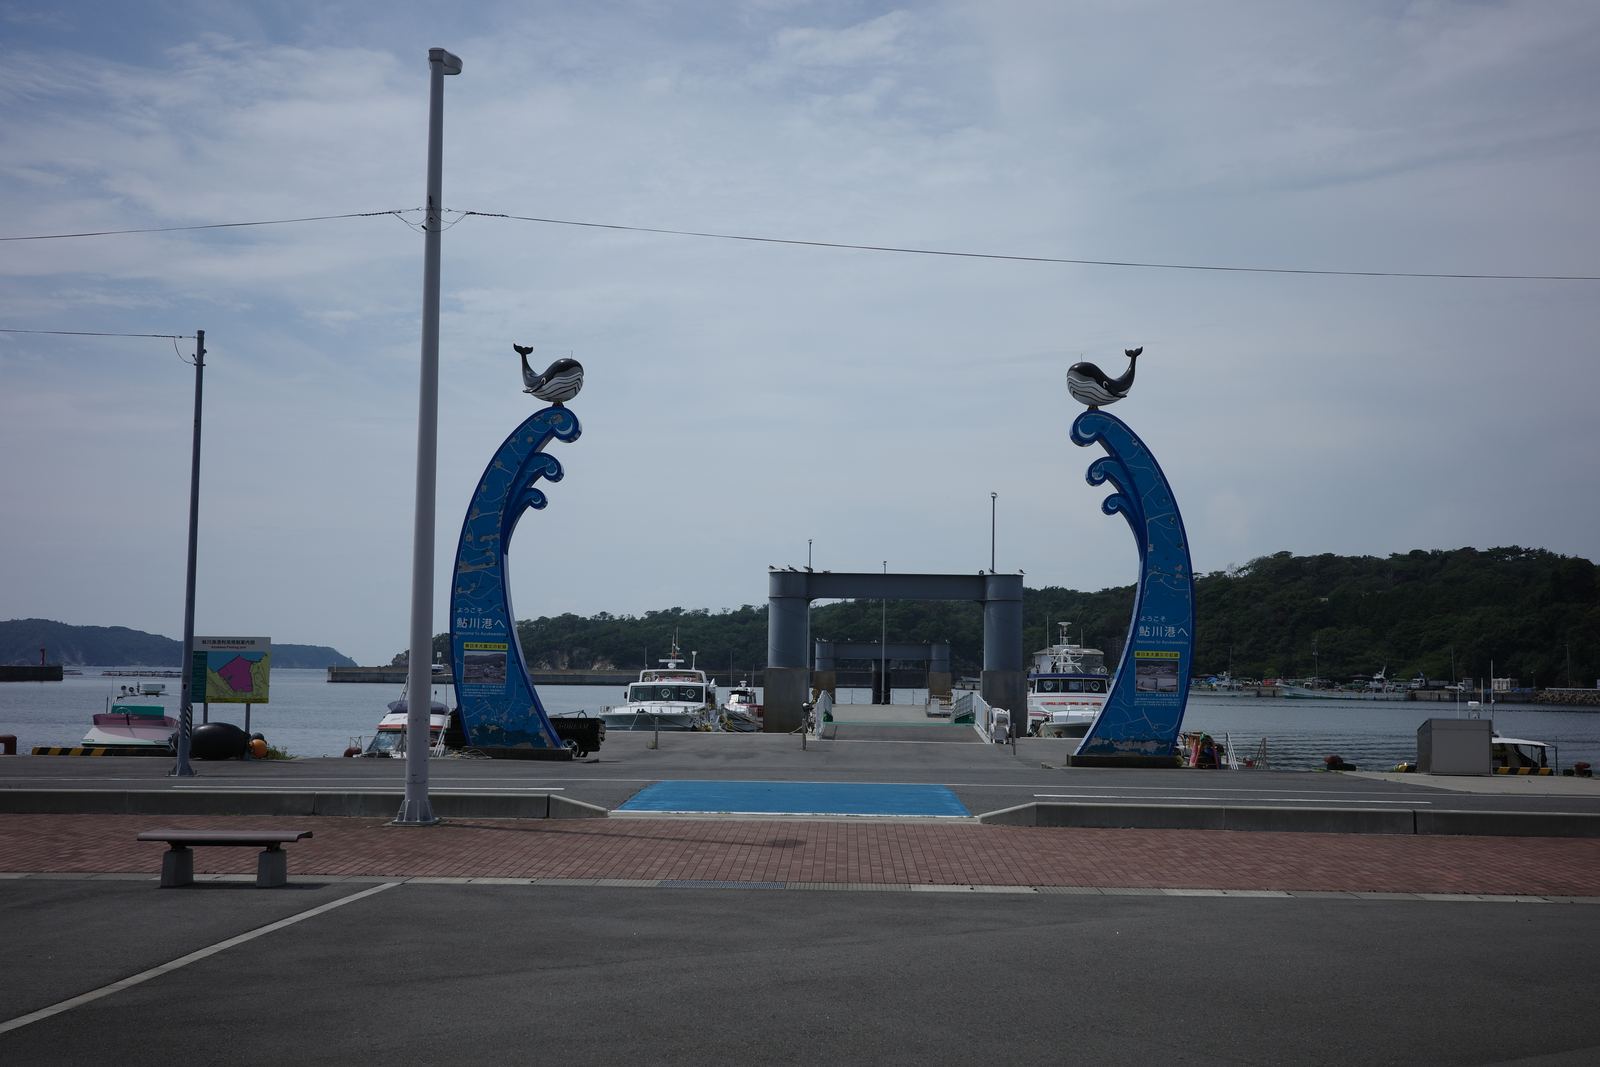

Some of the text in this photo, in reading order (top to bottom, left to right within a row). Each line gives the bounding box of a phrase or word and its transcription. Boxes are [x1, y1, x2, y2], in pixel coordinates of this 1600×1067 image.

[456, 616, 505, 630] 鮎川港へ
[1138, 625, 1188, 638] 鮎川港へ
